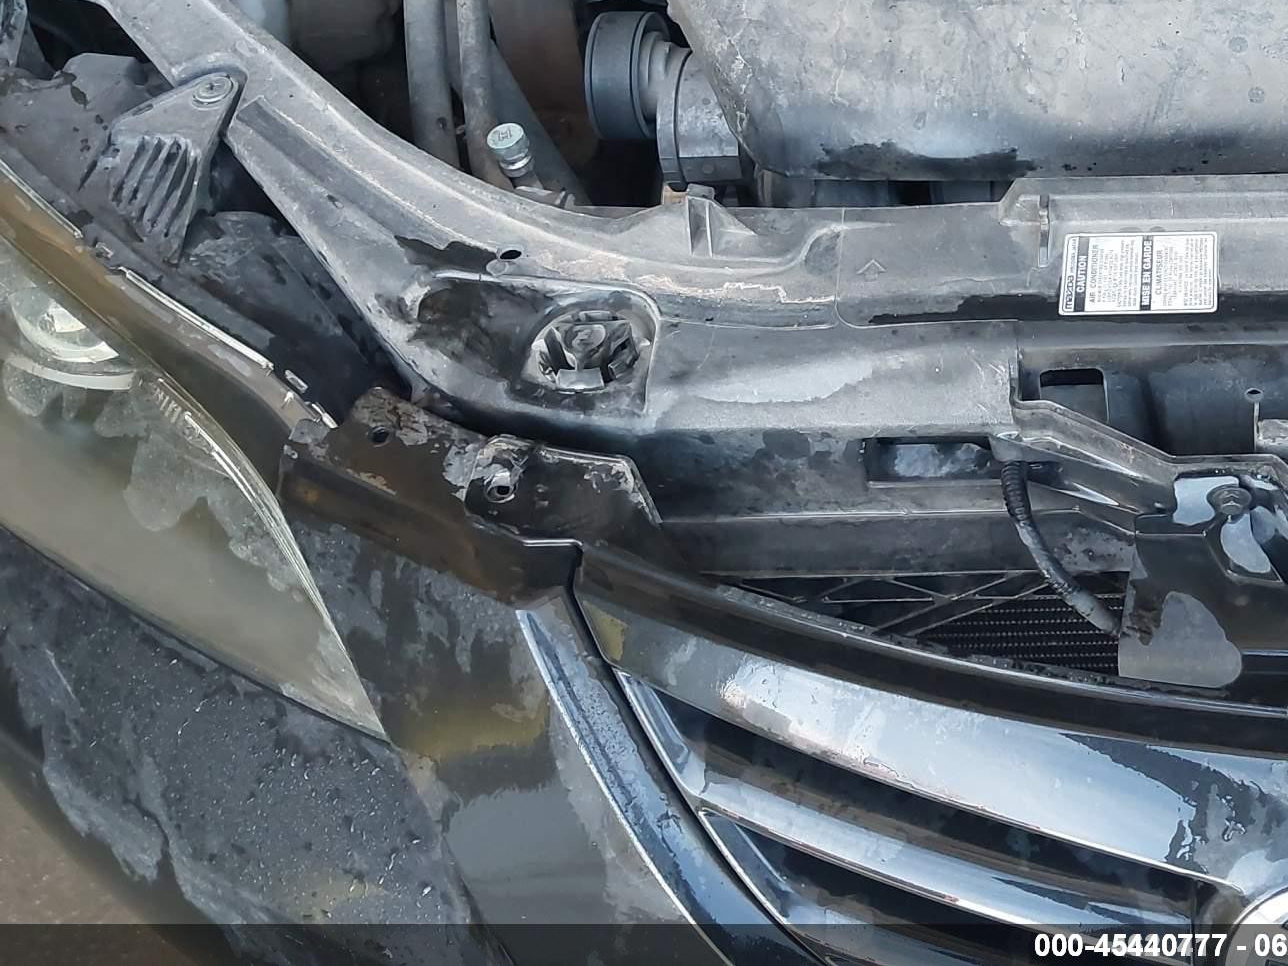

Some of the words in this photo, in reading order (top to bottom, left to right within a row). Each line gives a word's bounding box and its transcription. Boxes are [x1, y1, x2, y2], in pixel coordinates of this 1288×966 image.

[1142, 240, 1153, 270] GARDE
[1076, 255, 1088, 293] CAUTION
[1142, 271, 1151, 283] EN
[1141, 285, 1150, 306] MISE
